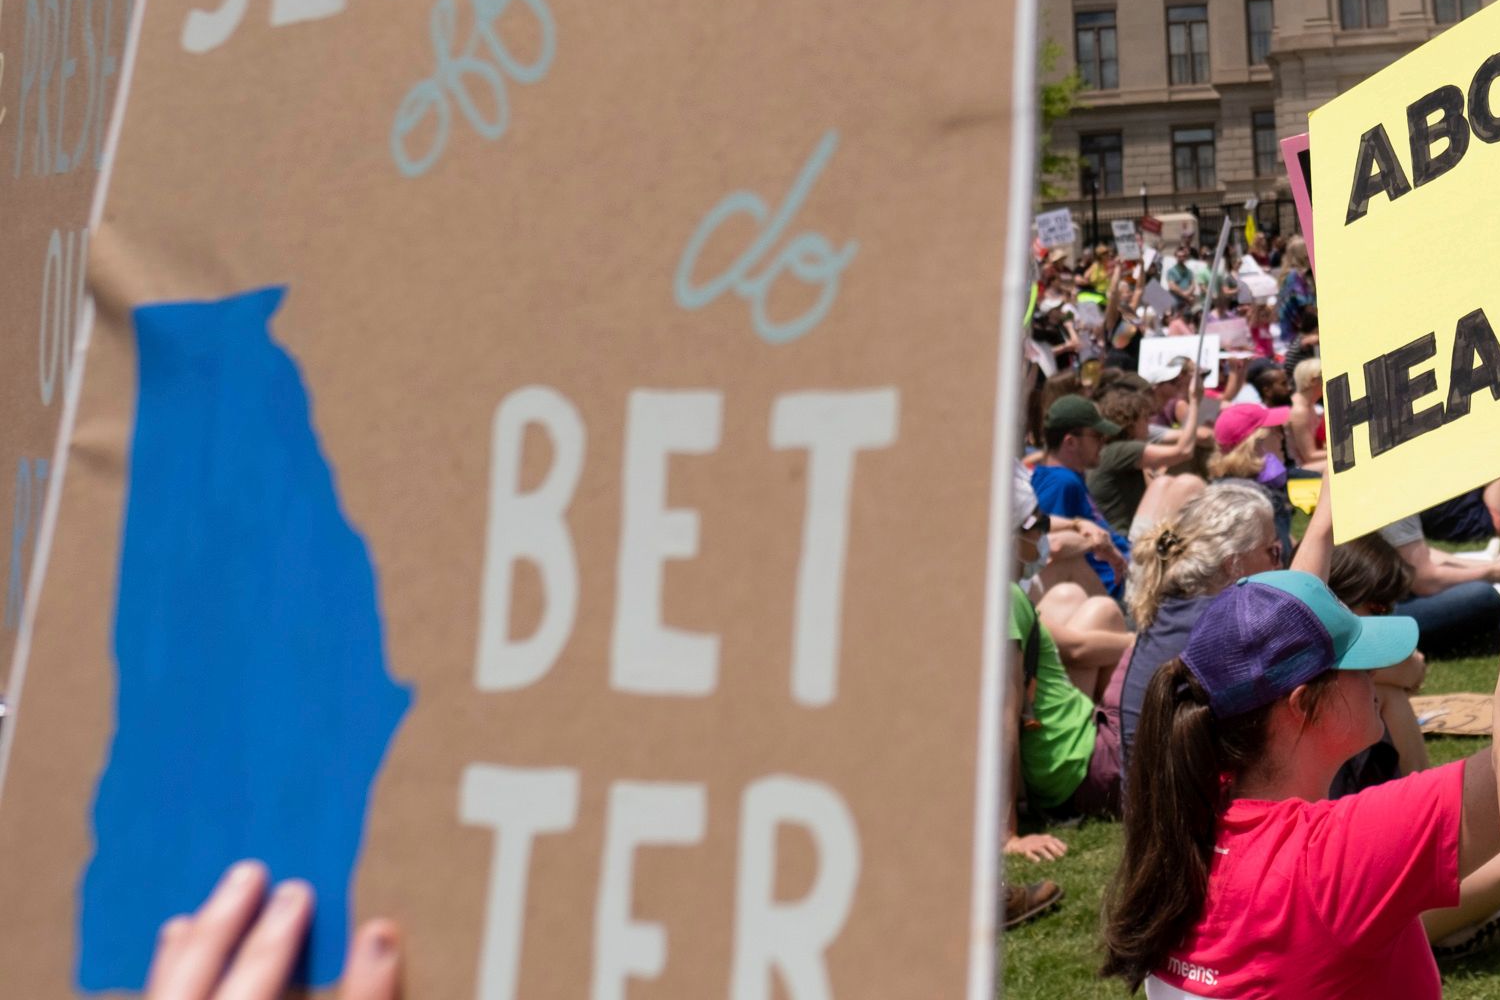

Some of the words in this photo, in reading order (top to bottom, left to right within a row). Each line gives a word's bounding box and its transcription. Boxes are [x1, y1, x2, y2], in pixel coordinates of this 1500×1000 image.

[674, 129, 859, 345] do
[473, 384, 899, 708] BET
[1167, 955, 1220, 986] means:
